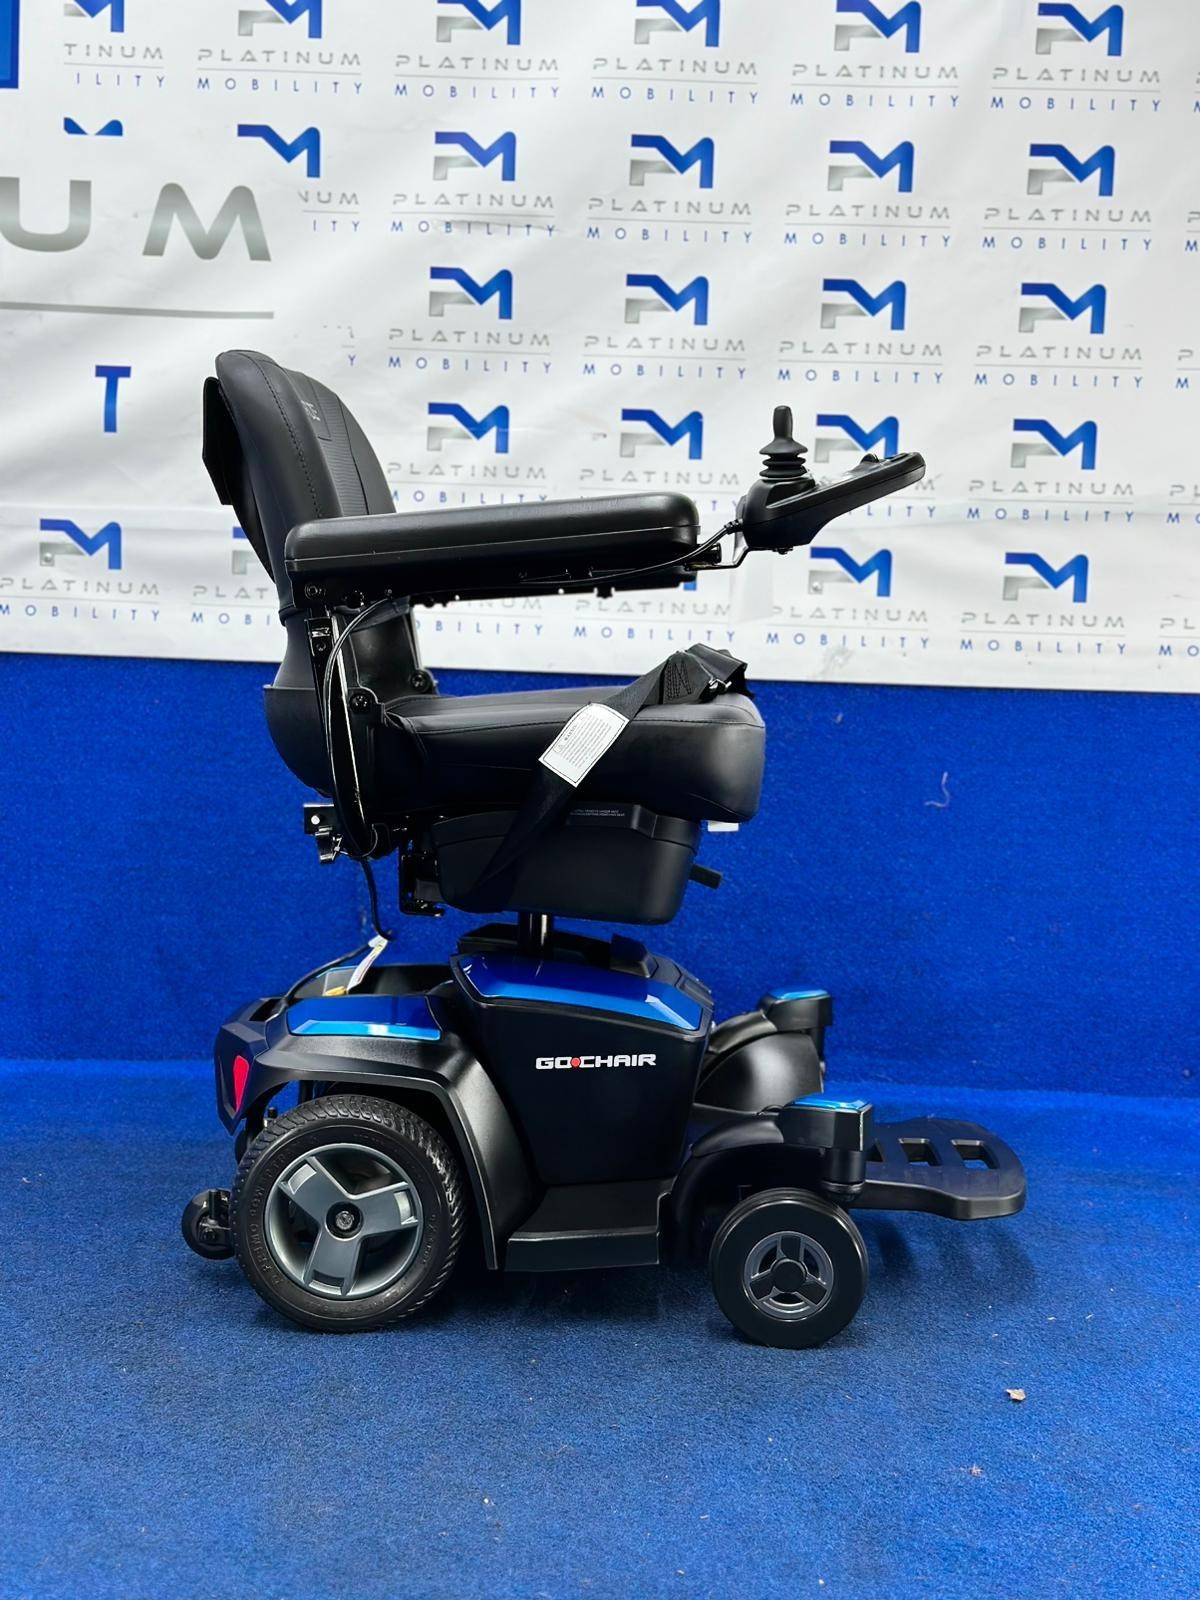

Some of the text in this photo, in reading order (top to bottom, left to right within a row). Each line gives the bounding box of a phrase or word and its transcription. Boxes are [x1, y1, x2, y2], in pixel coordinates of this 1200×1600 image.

[198, 49, 360, 66] PLATINUM
[395, 55, 559, 71] PLATINUM
[593, 58, 757, 75] PLATINUM
[792, 64, 958, 79] PLATINUM
[992, 67, 1160, 83] PLATINUM
[197, 77, 362, 95] MOBILITY
[394, 84, 560, 98] MOBILITY
[592, 86, 758, 103] MOBILITY
[790, 93, 958, 107] MOBILITY
[990, 97, 1161, 111] MOBILITY
[393, 193, 554, 209] PLATINUM
[588, 198, 751, 215] PLATINUM
[785, 204, 950, 220] PLATINUM
[984, 207, 1151, 223] PLATINUM
[390, 220, 554, 236] MOBILITY
[587, 226, 752, 243] MOBILITY
[784, 232, 951, 247] MOBILITY
[982, 236, 1152, 250] MOBILITY
[388, 328, 550, 346] PLATINUM
[584, 335, 745, 351] PLATINUM
[779, 340, 942, 356] PLATINUM
[976, 345, 1142, 360] PLATINUM
[388, 356, 551, 374] MOBILITY
[582, 363, 746, 379] MOBILITY
[777, 369, 943, 384] MOBILITY
[974, 373, 1143, 388] MOBILITY
[387, 462, 546, 479] PLATINUM
[579, 469, 740, 486] PLATINUM
[968, 480, 1134, 495] PLATINUM
[966, 508, 1135, 522] MOBILITY
[961, 612, 1125, 628] PLATINUM
[573, 626, 735, 642] MOBILITY
[766, 632, 929, 649] MOBILITY
[960, 639, 1126, 654] MOBILITY
